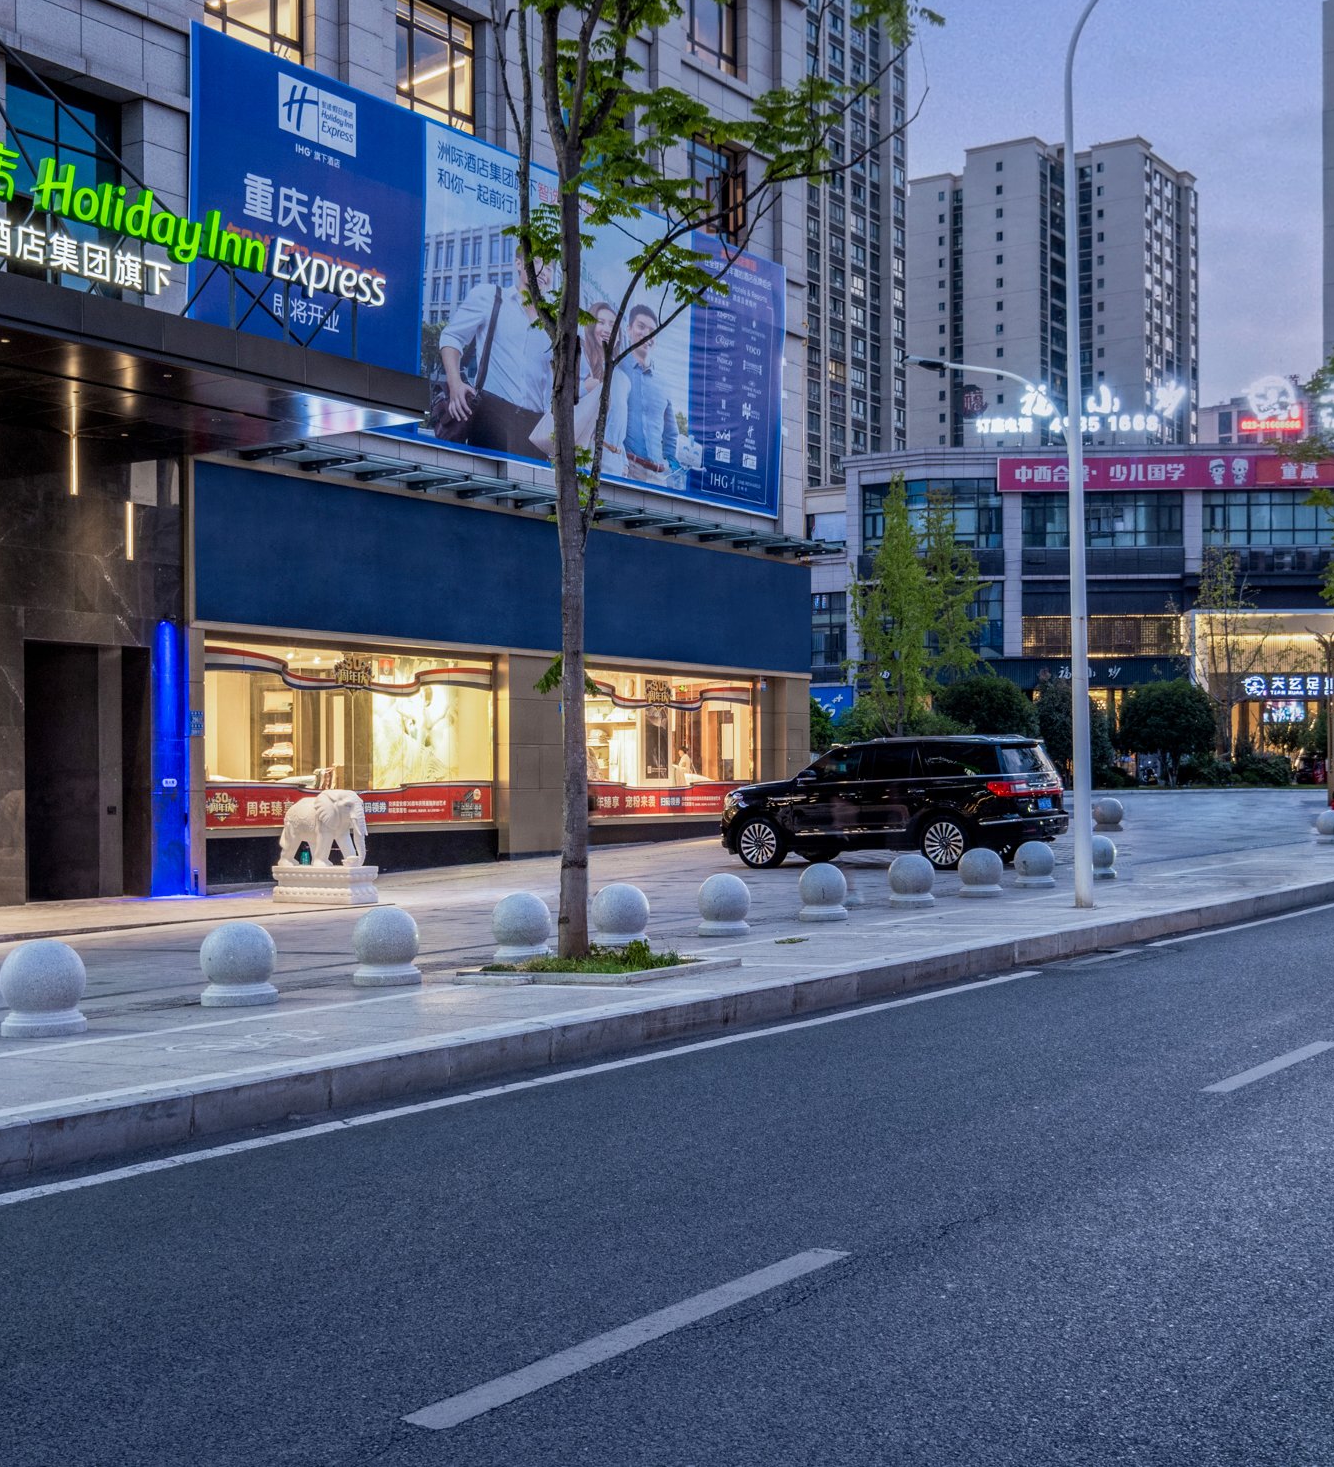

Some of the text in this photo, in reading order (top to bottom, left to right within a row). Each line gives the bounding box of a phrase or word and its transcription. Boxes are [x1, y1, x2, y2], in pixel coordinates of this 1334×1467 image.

[321, 110, 354, 130] Holiday Inn
[321, 121, 354, 143] Express
[295, 143, 341, 169] IHG 旗下酒店
[243, 172, 373, 254] 重庆铜梁
[33, 157, 202, 265] Holiday
[204, 210, 267, 274] Inn
[271, 236, 387, 308] Express
[715, 429, 731, 441] avid
[710, 472, 729, 489] IHG
[214, 792, 229, 803] 30
[624, 795, 656, 808] 宠粉来袭
